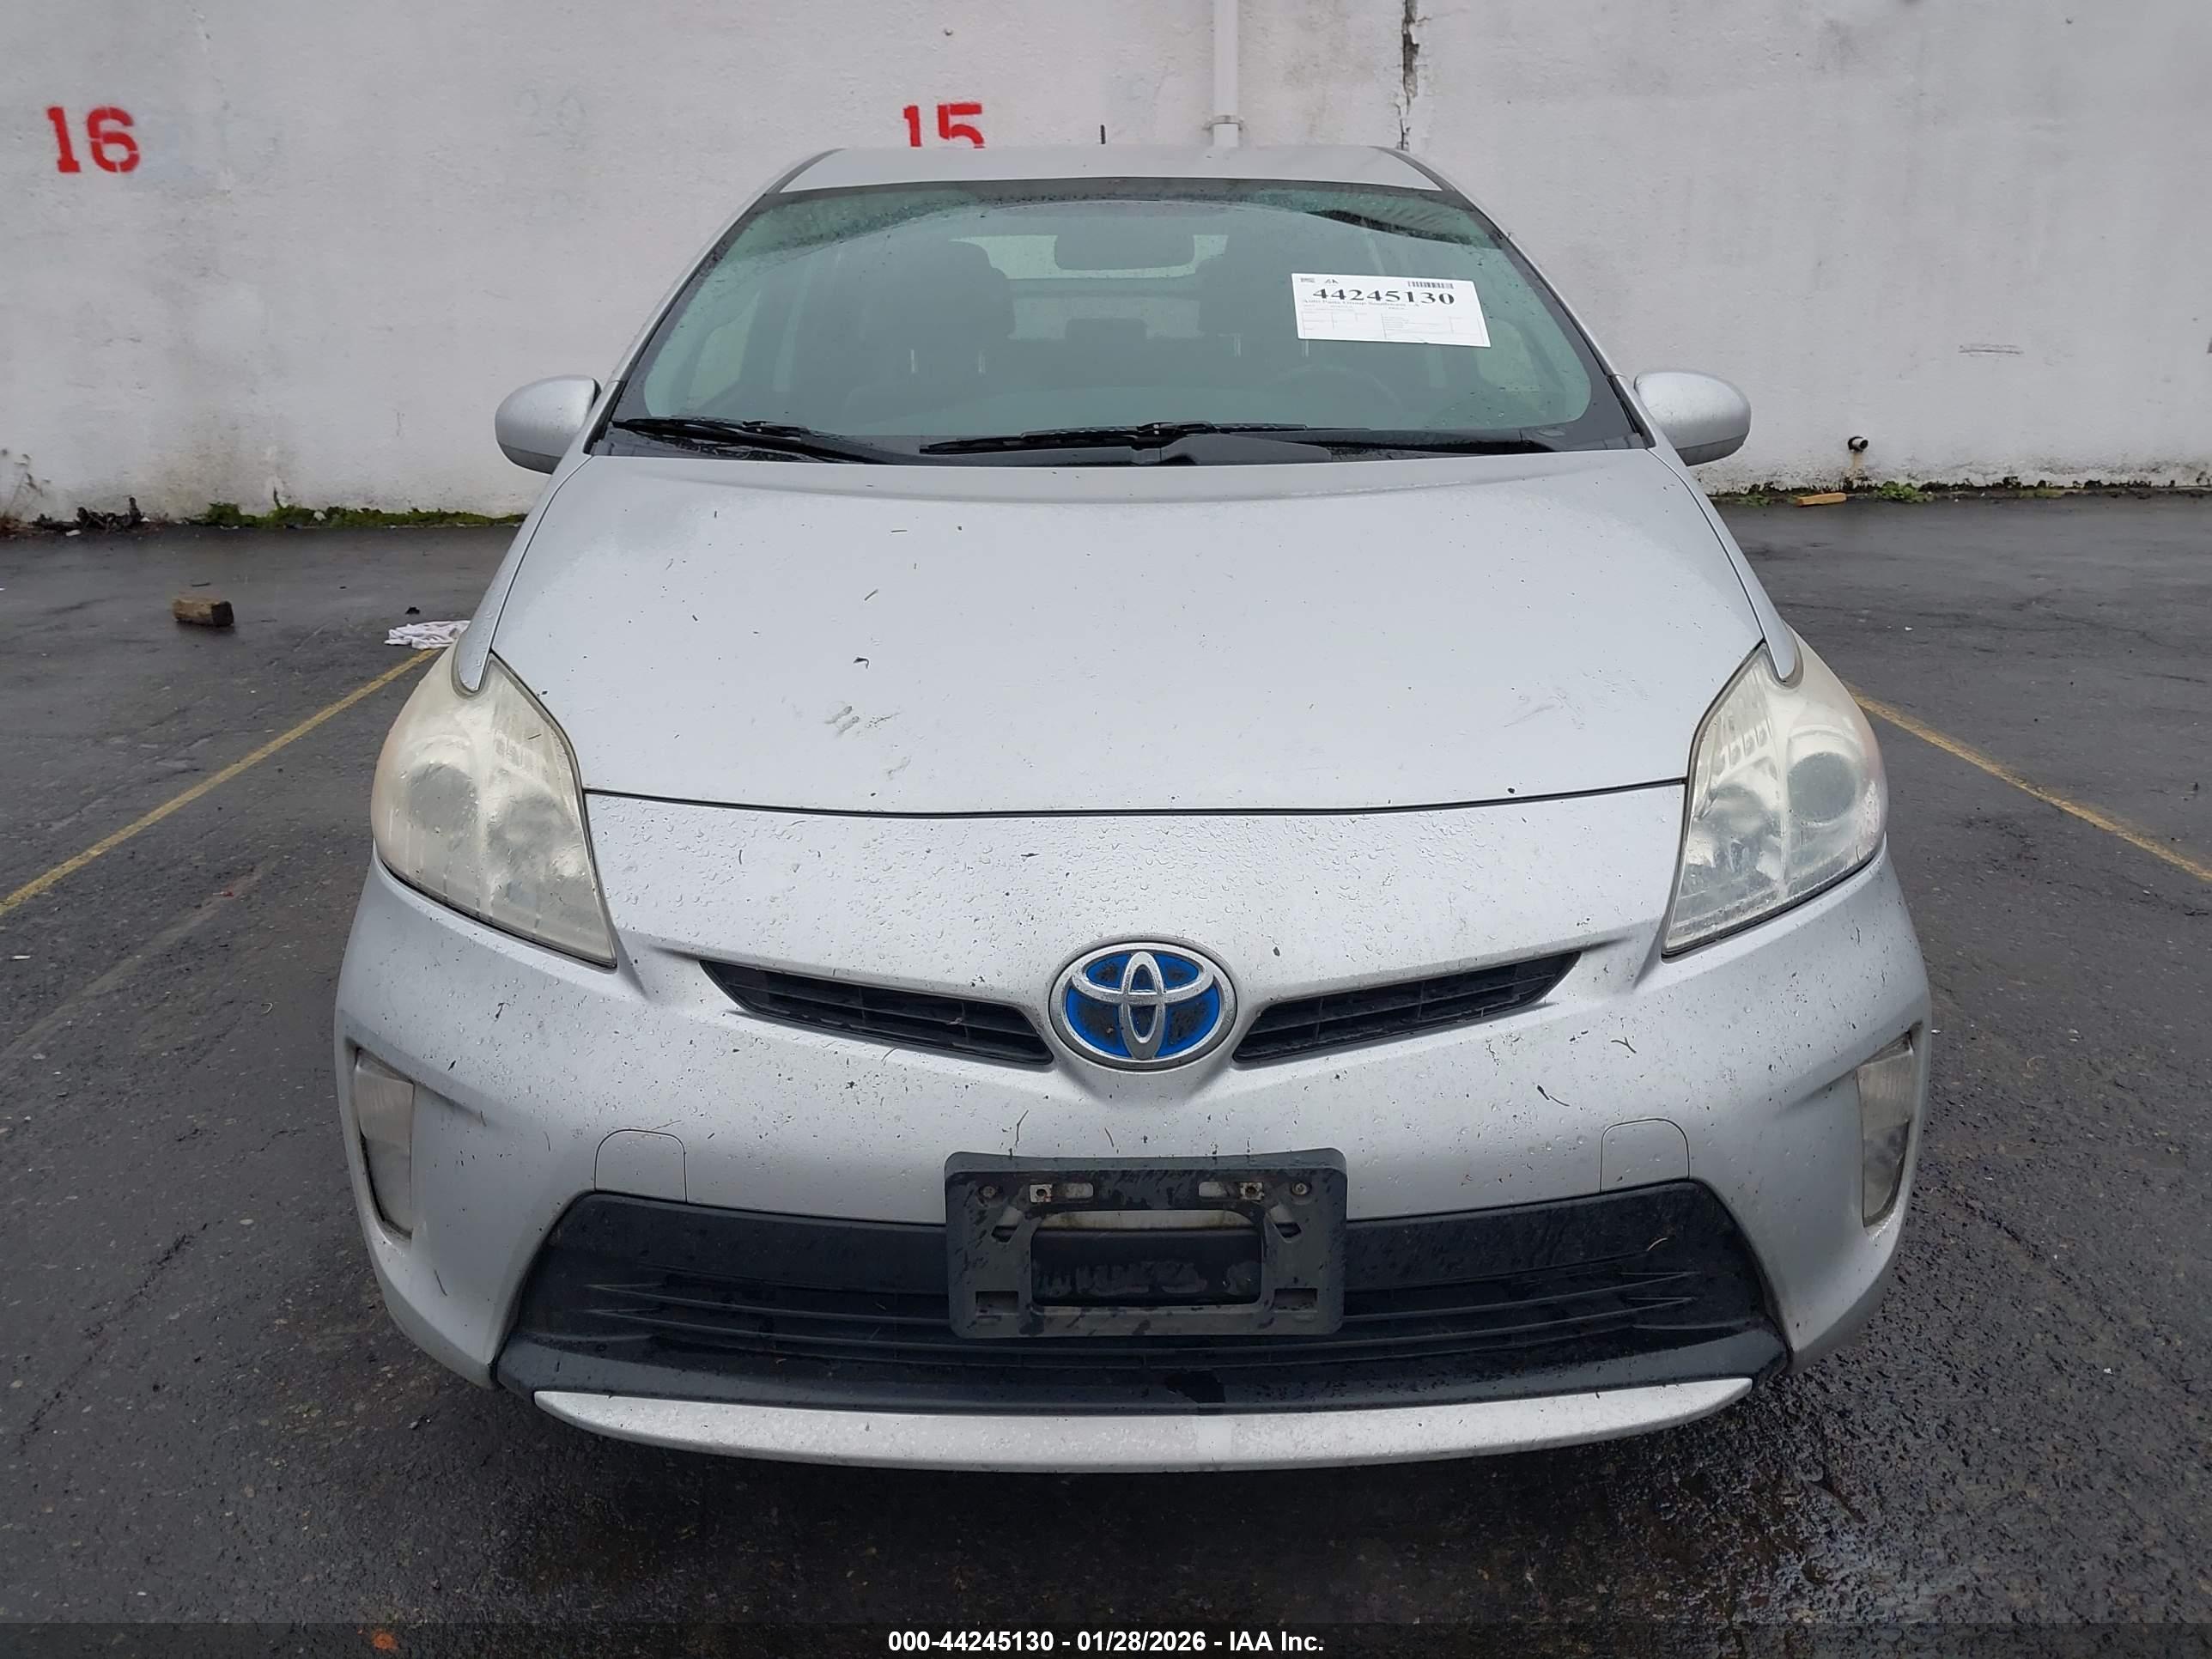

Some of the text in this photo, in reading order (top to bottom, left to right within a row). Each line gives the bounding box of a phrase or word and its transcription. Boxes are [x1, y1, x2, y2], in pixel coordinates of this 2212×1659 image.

[47, 106, 140, 173] 16
[903, 102, 985, 149] 15
[1312, 288, 1455, 305] 44245130
